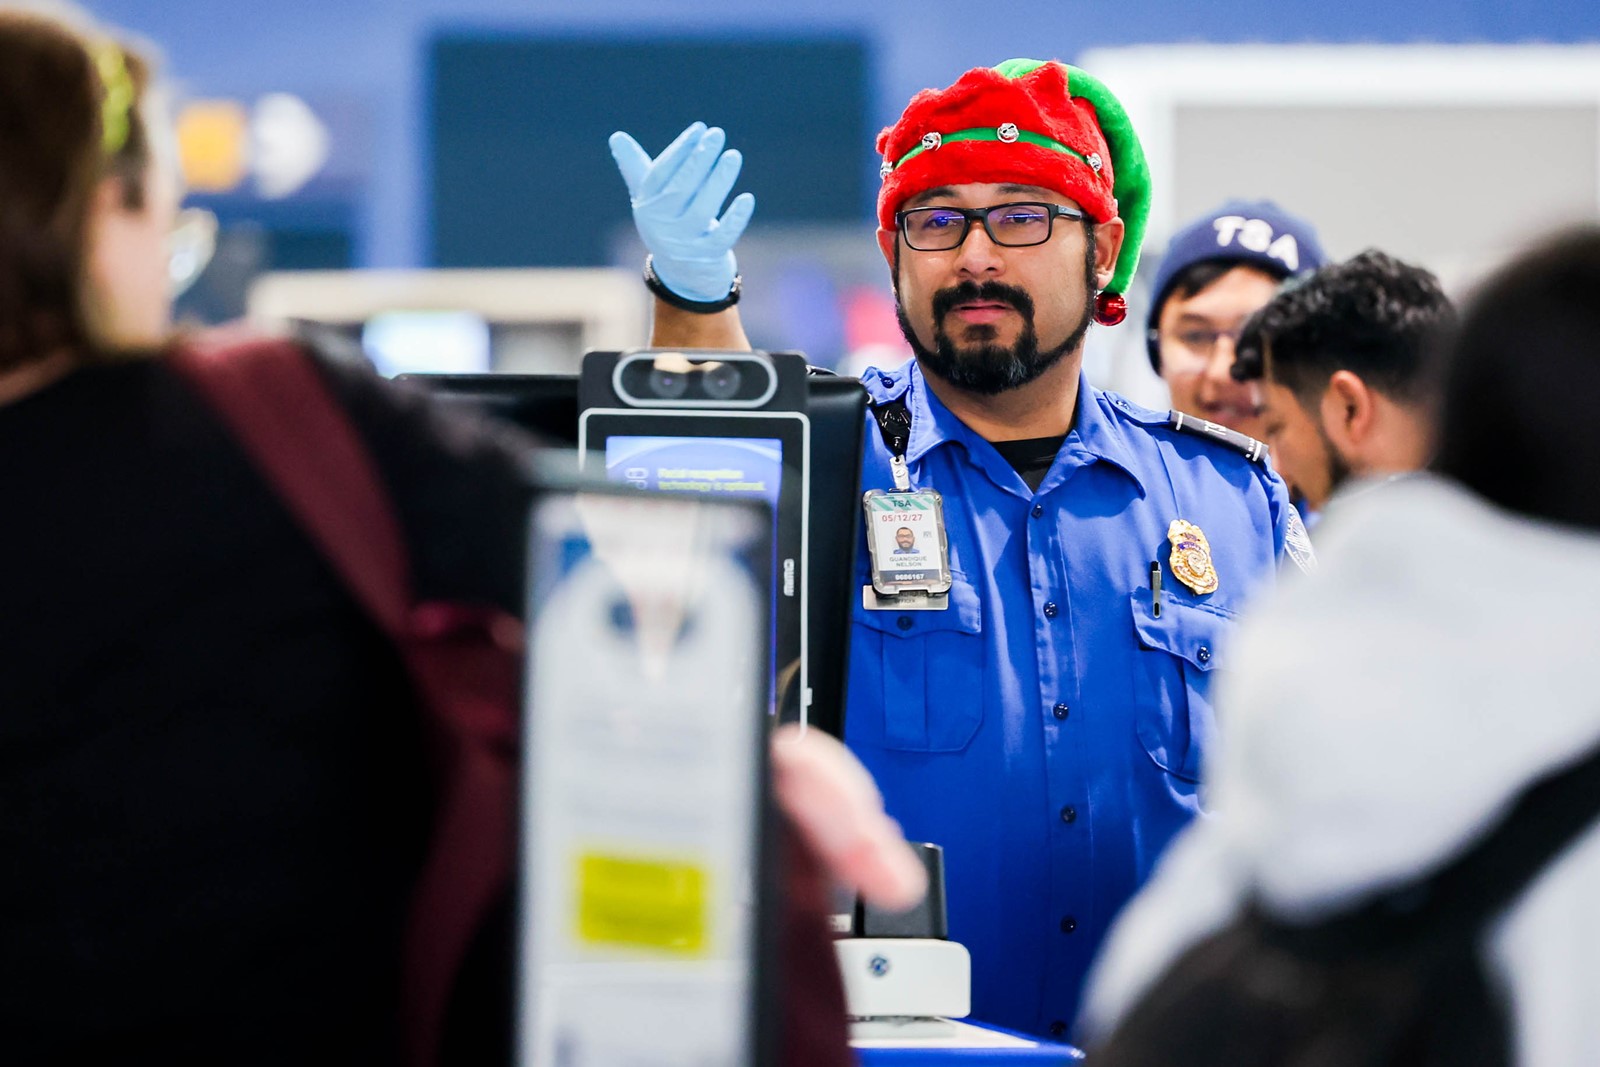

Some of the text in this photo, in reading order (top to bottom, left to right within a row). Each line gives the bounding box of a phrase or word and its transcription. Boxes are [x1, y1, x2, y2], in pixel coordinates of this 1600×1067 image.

[1213, 215, 1300, 271] TSA
[892, 499, 912, 508] TSA
[882, 514, 923, 522] 05/12/27
